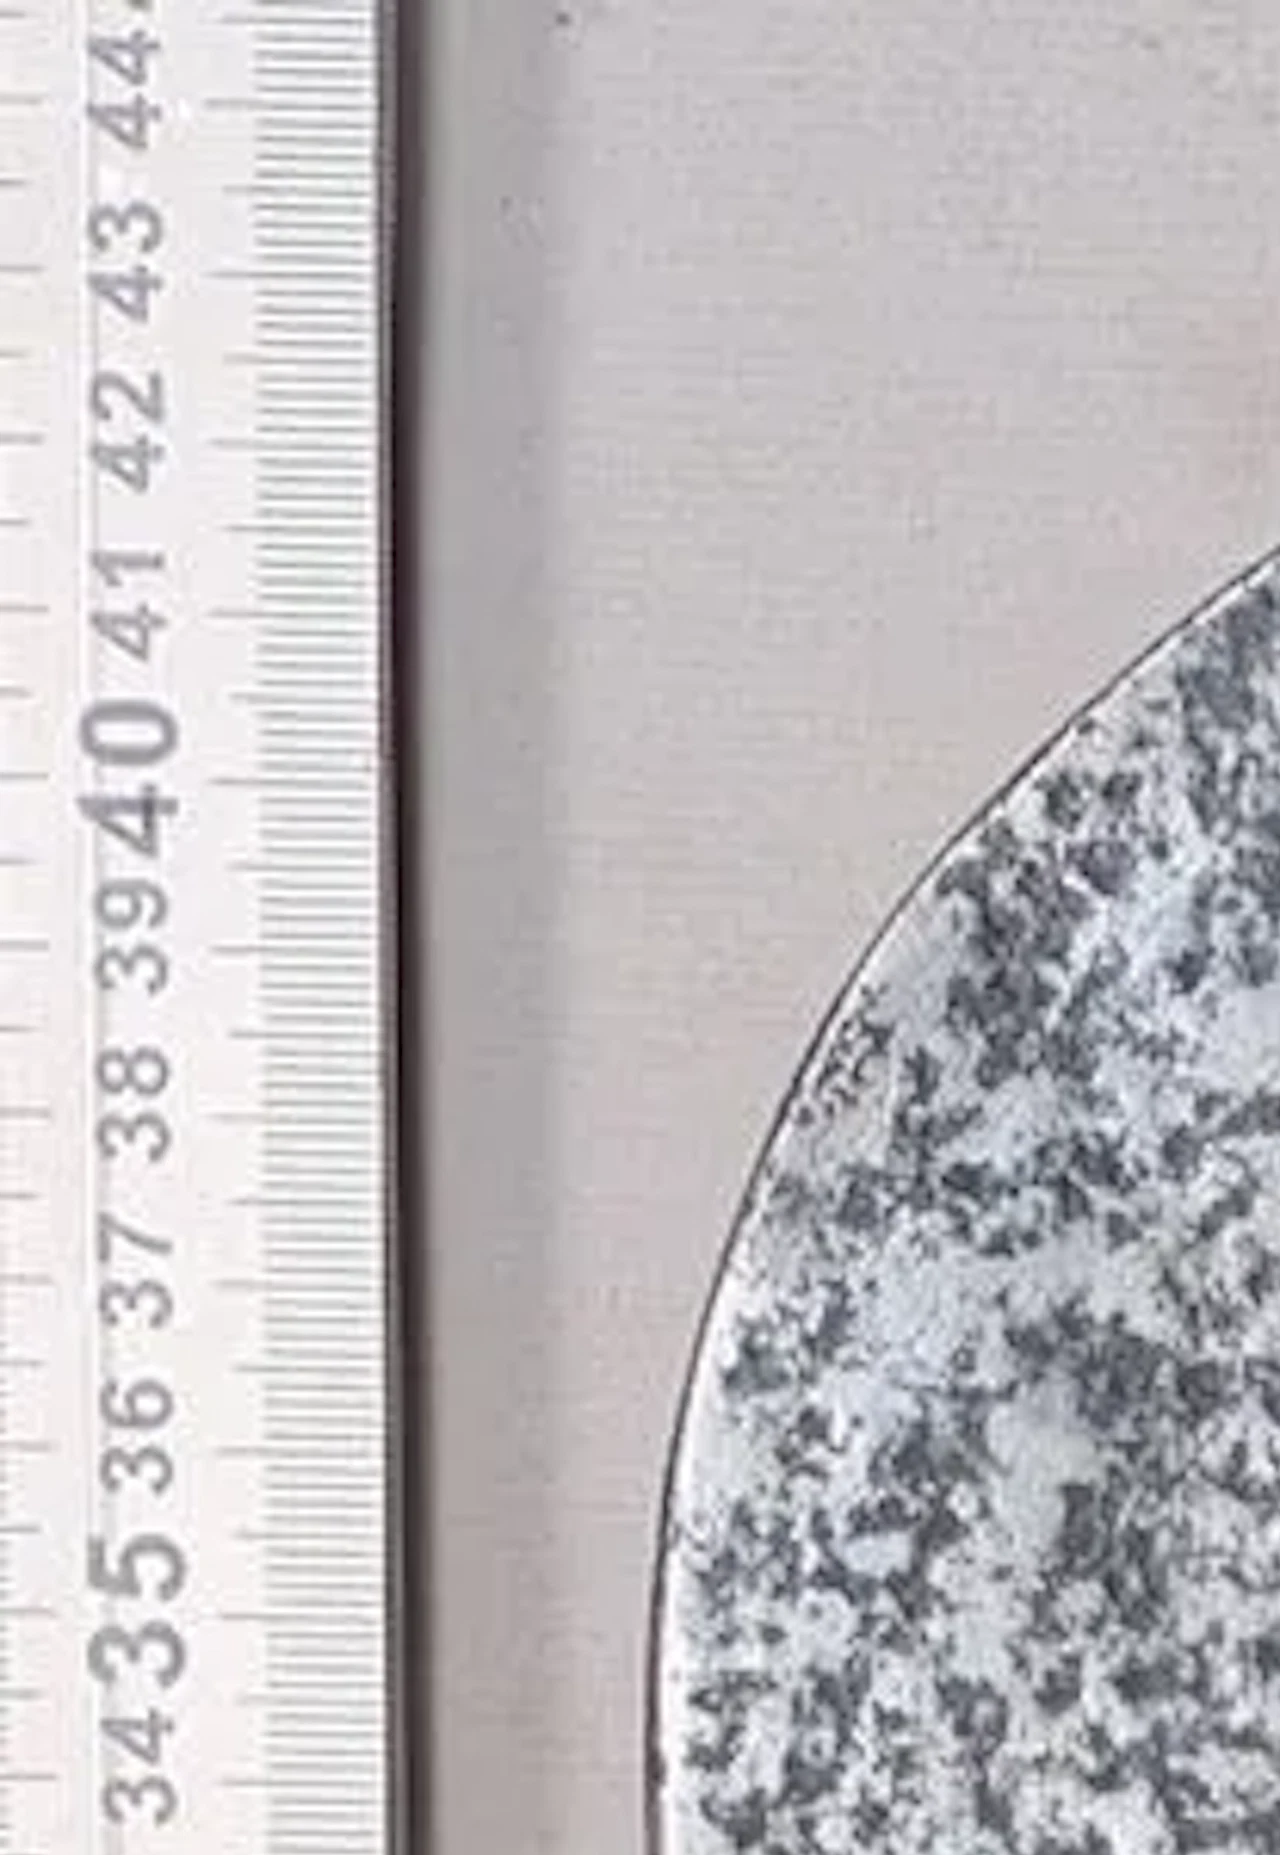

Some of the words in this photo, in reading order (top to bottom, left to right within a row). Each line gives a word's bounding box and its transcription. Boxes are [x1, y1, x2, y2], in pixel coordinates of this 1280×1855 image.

[85, 29, 163, 152] 44
[86, 200, 164, 323] 43
[88, 371, 165, 494] 42
[88, 548, 167, 663] 41
[77, 699, 179, 858] 40
[92, 879, 169, 996] 39
[93, 1046, 172, 1163] 38
[95, 1211, 174, 1330] 37
[99, 1378, 175, 1496] 36
[86, 1534, 188, 1691] 35
[99, 1707, 178, 1826] 34
